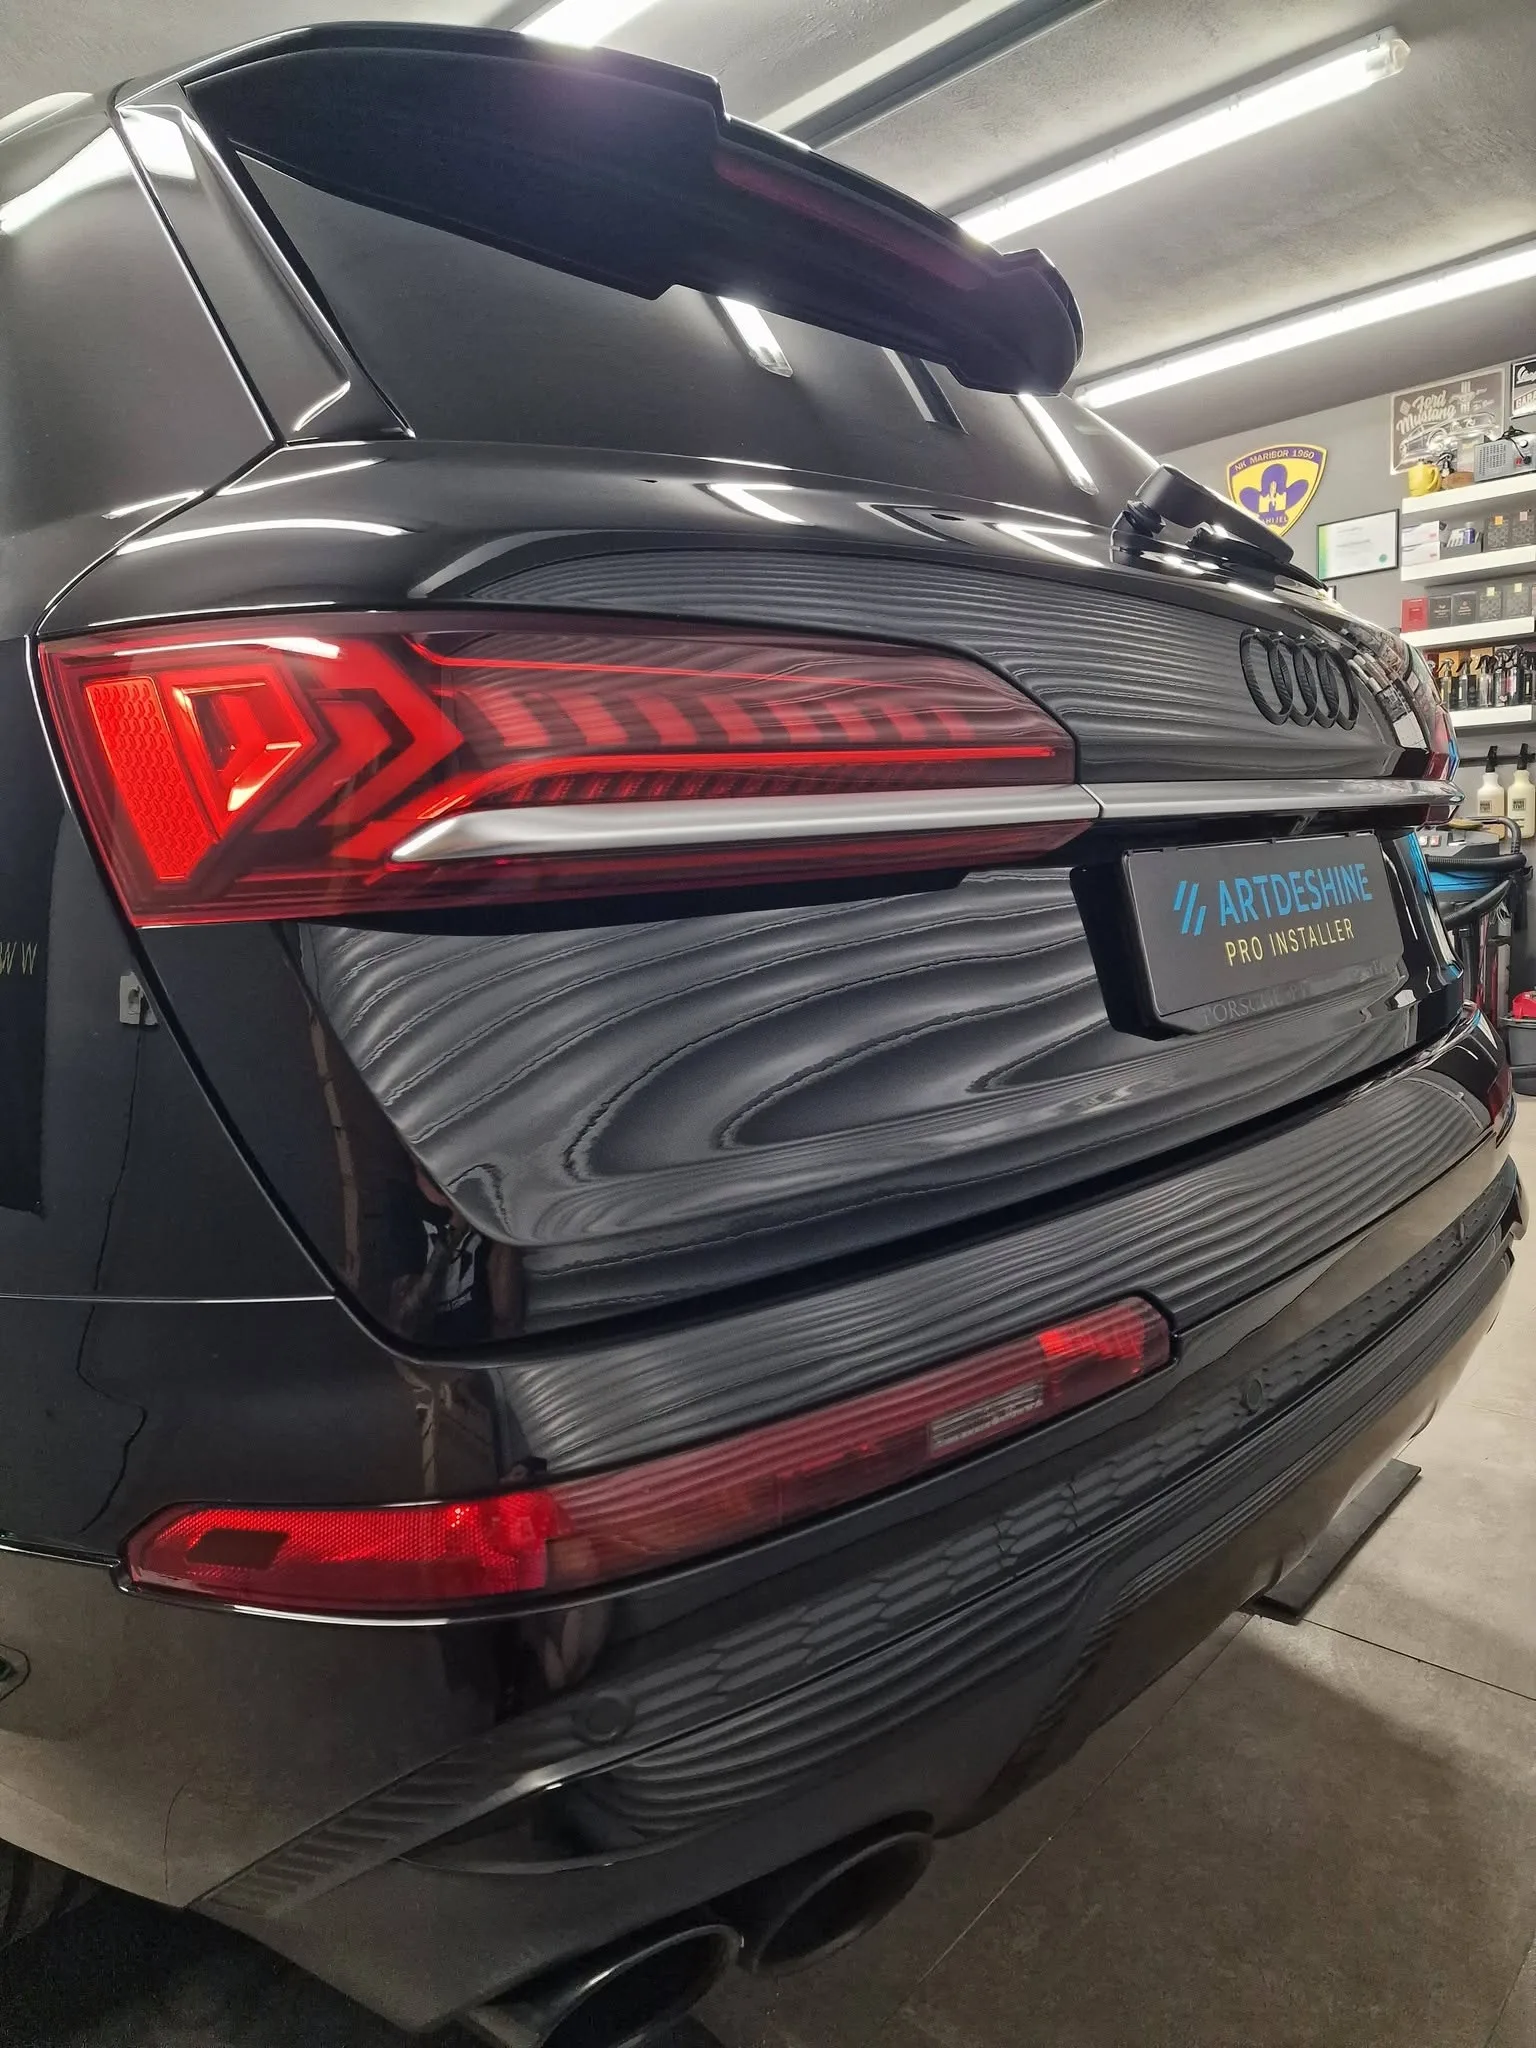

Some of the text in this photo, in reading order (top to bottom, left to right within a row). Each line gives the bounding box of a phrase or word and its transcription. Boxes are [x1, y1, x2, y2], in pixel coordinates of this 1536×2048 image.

[1412, 389, 1447, 411] Ford
[1396, 404, 1457, 435] Mustang
[1234, 448, 1315, 472] NK MARIBOR 1960
[1219, 863, 1373, 926] ARTDESHINE
[1225, 918, 1355, 967] PRO INSTALLER
